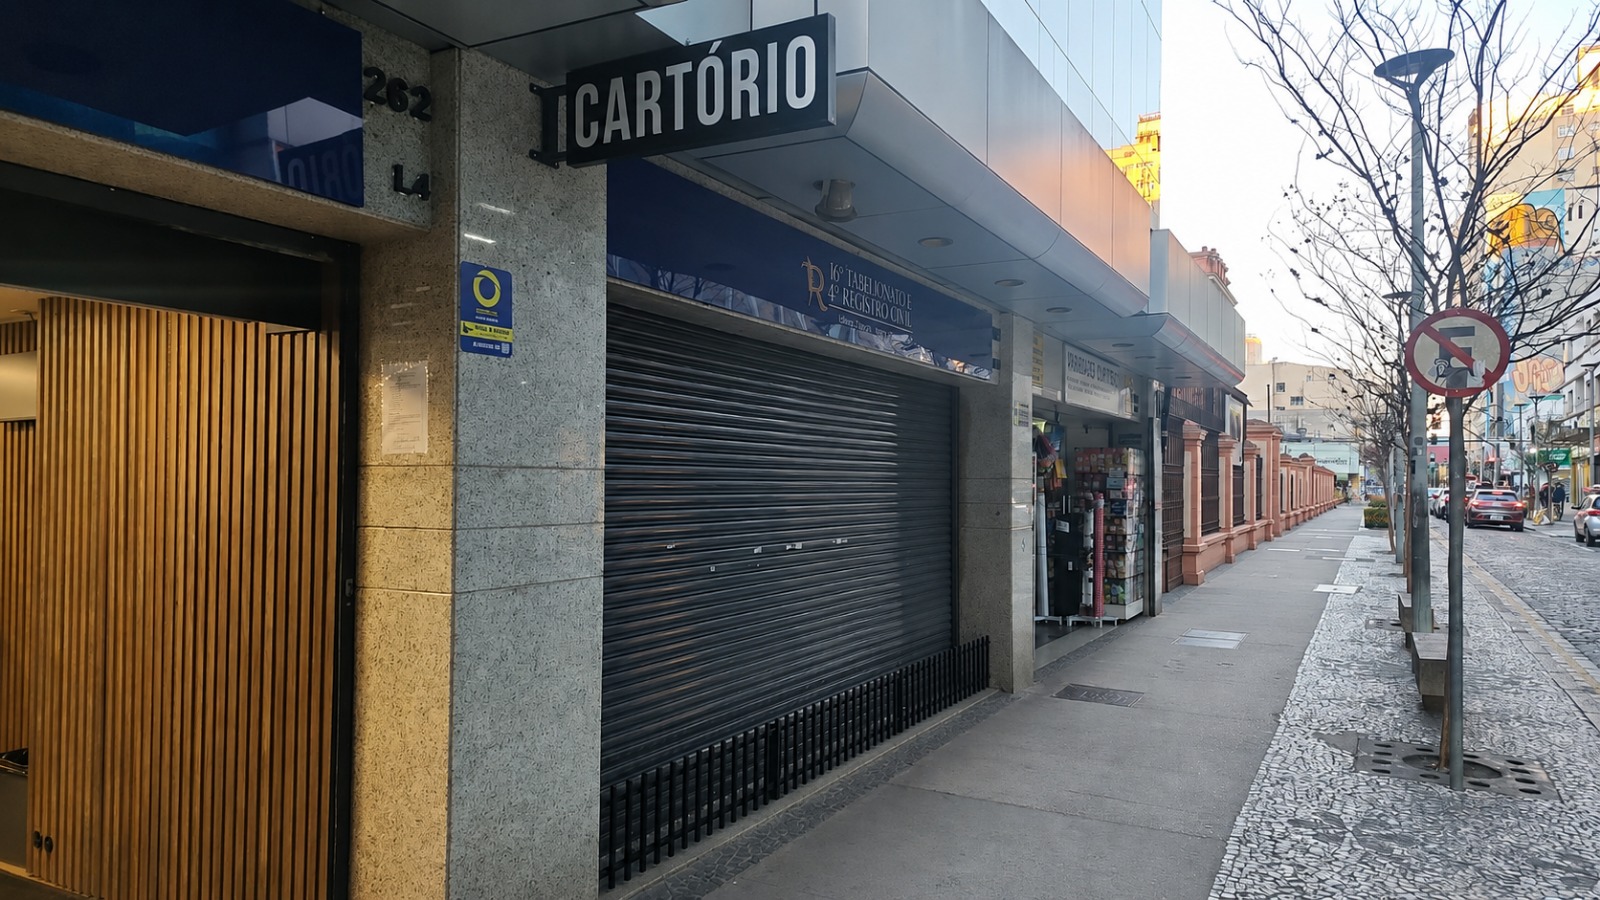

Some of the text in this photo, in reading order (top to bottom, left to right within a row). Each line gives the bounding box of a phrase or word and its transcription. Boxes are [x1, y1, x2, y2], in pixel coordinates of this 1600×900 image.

[363, 66, 432, 122] 262
[575, 40, 816, 148] CARTÓRIO
[392, 164, 431, 200] L4
[843, 287, 889, 319] REGISTRO
[890, 305, 912, 327] CIVIL
[846, 267, 906, 306] TABELIONATO
[907, 295, 913, 310] E
